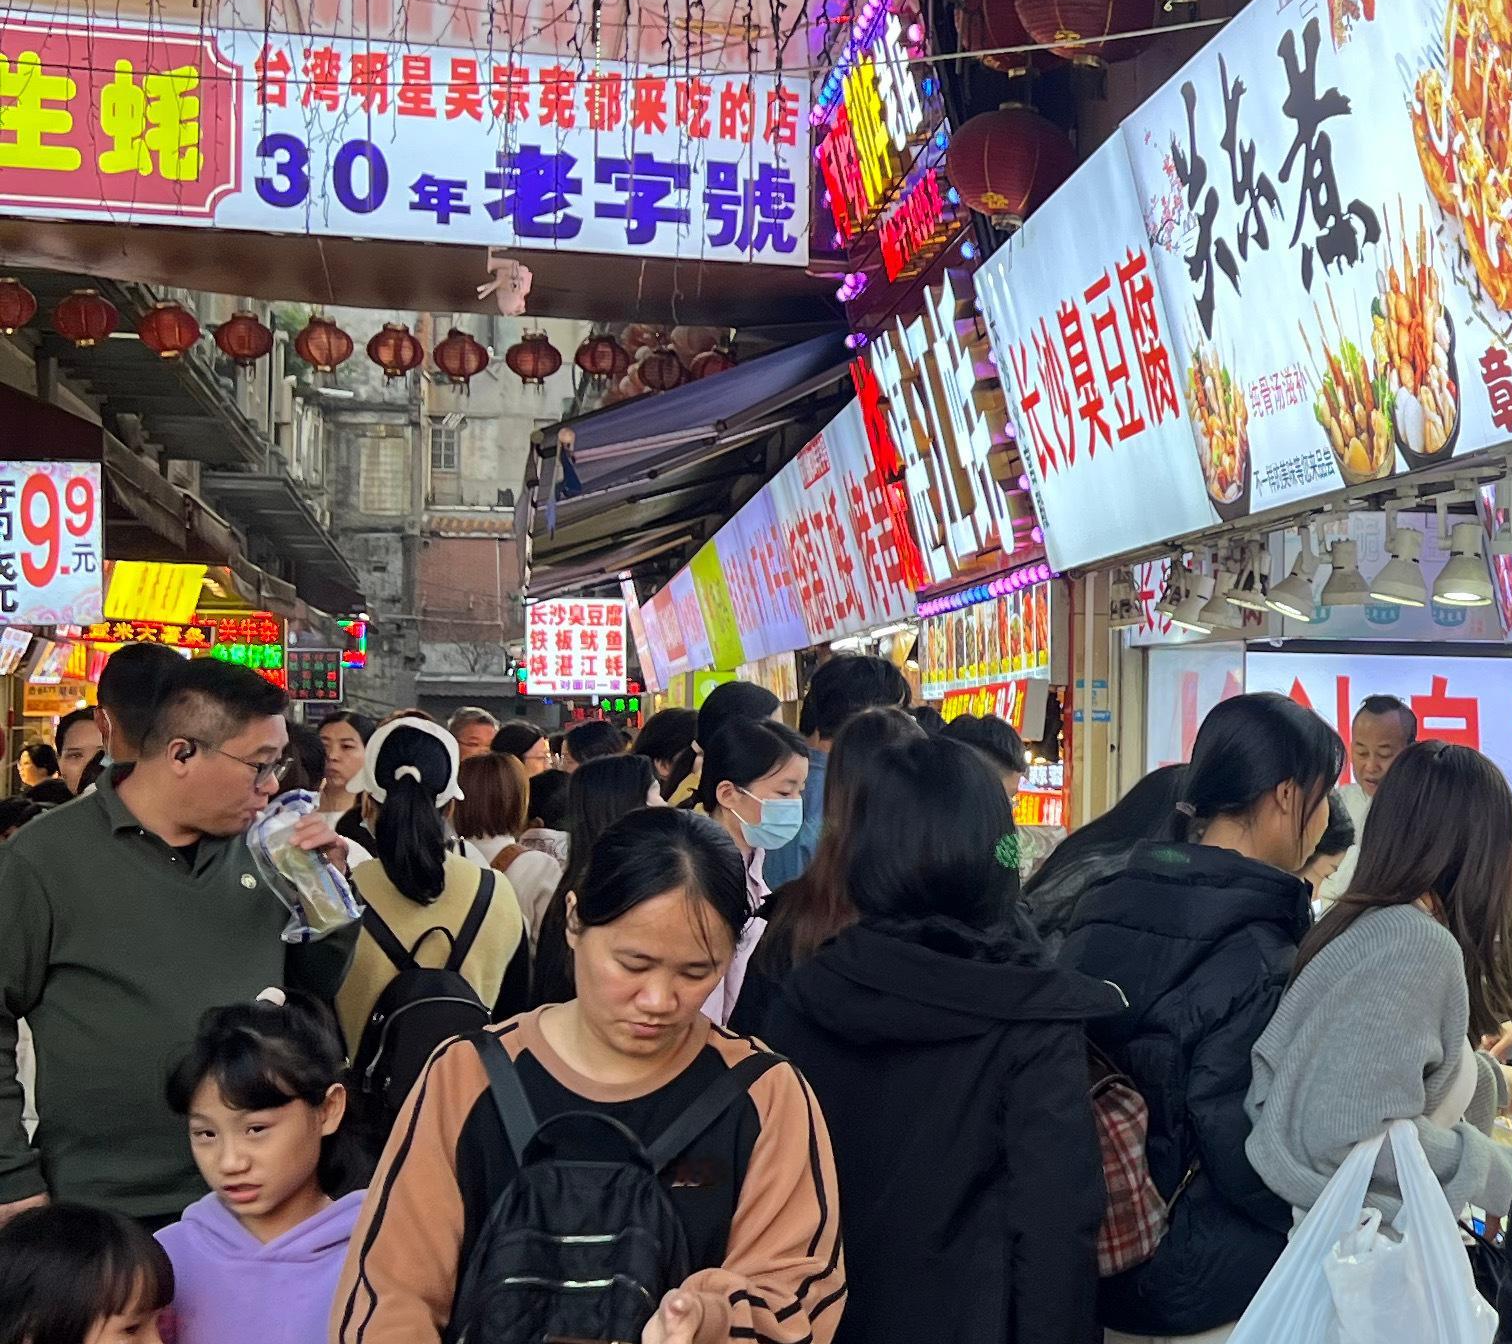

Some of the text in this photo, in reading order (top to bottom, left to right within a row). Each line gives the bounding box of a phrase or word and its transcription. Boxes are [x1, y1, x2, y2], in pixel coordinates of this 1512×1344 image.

[253, 43, 800, 147] 台湾明星吴宗宪都来吃的店
[1007, 245, 1181, 482] 长沙臭豆腐
[529, 603, 624, 627] 长沙臭豆腐
